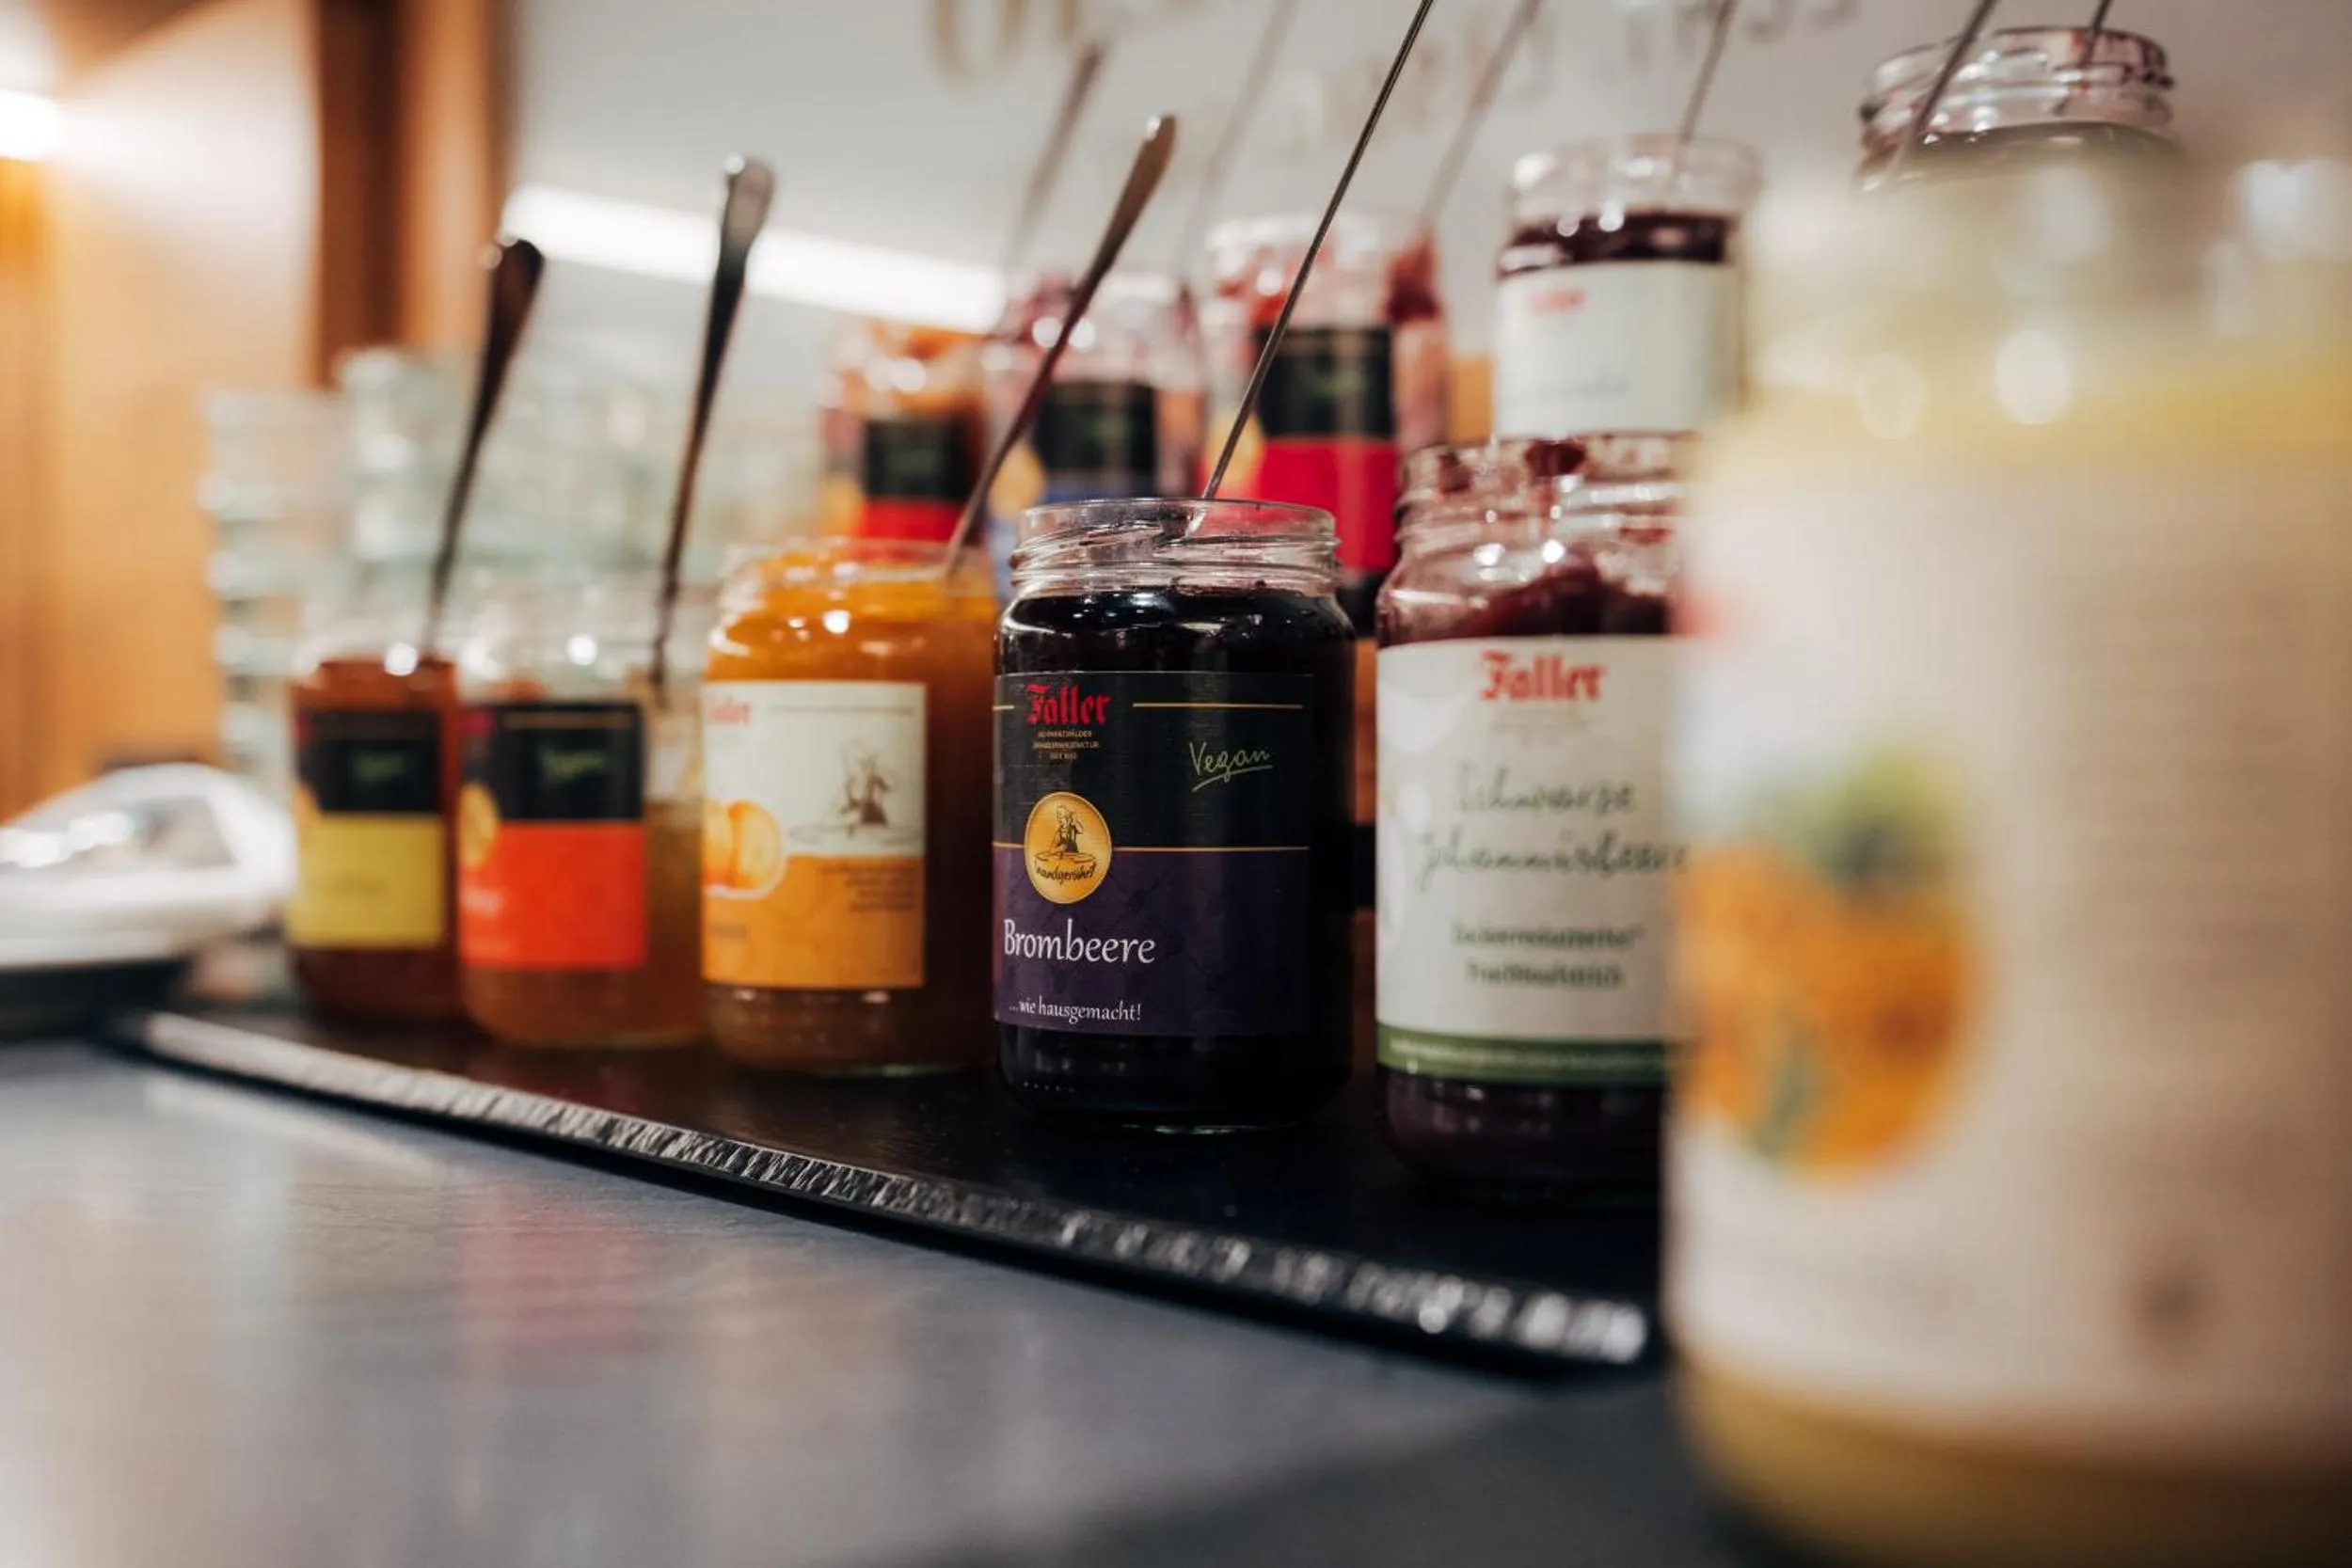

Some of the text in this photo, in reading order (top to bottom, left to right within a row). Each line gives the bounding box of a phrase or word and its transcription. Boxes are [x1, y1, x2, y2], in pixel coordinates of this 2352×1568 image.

[1482, 648, 1608, 702] Faller
[1027, 682, 1112, 725] Faller
[1188, 741, 1270, 784] Vegan
[1003, 918, 1155, 964] Brombeere
[1038, 995, 1141, 1024] hausgemacht!
